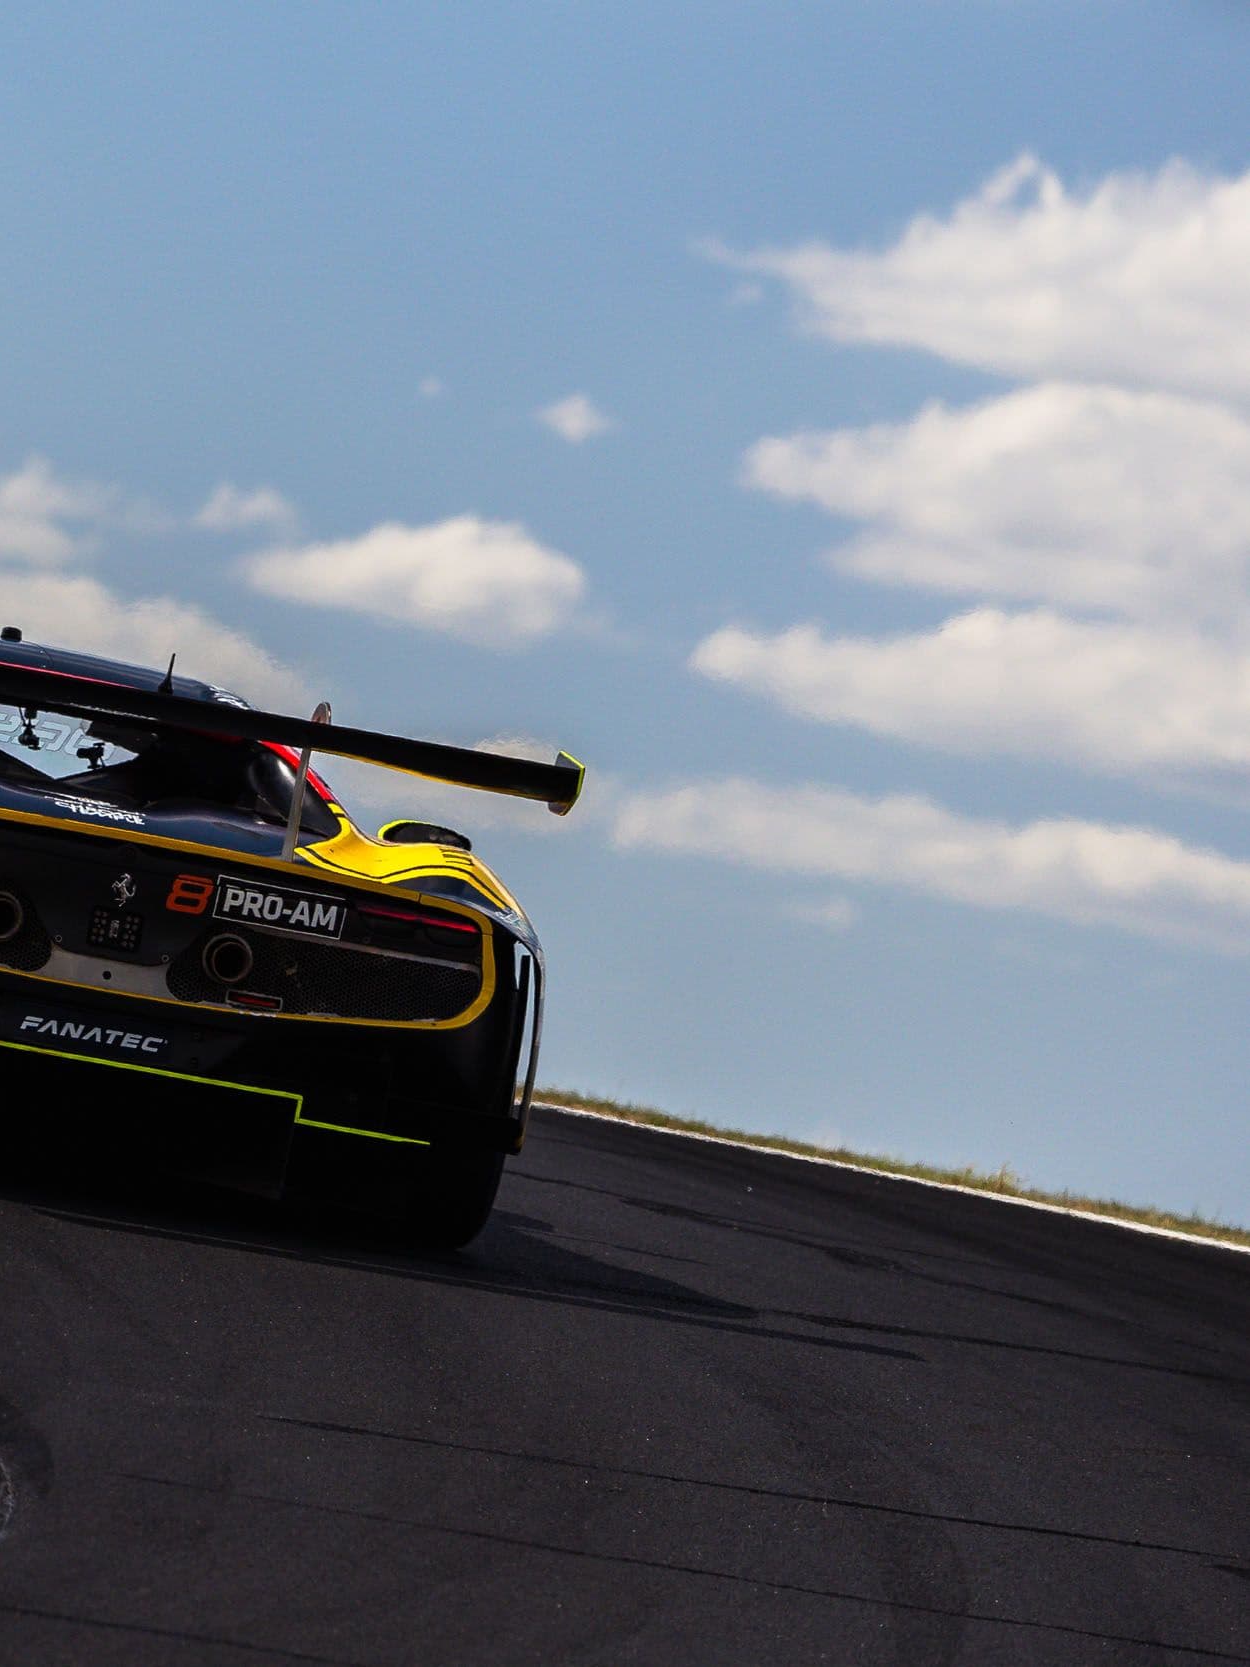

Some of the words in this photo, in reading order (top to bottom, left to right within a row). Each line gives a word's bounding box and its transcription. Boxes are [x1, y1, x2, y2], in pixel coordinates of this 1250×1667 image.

[165, 874, 215, 915] 8
[222, 885, 339, 932] PRO-AM
[20, 1015, 164, 1053] FANATEC
